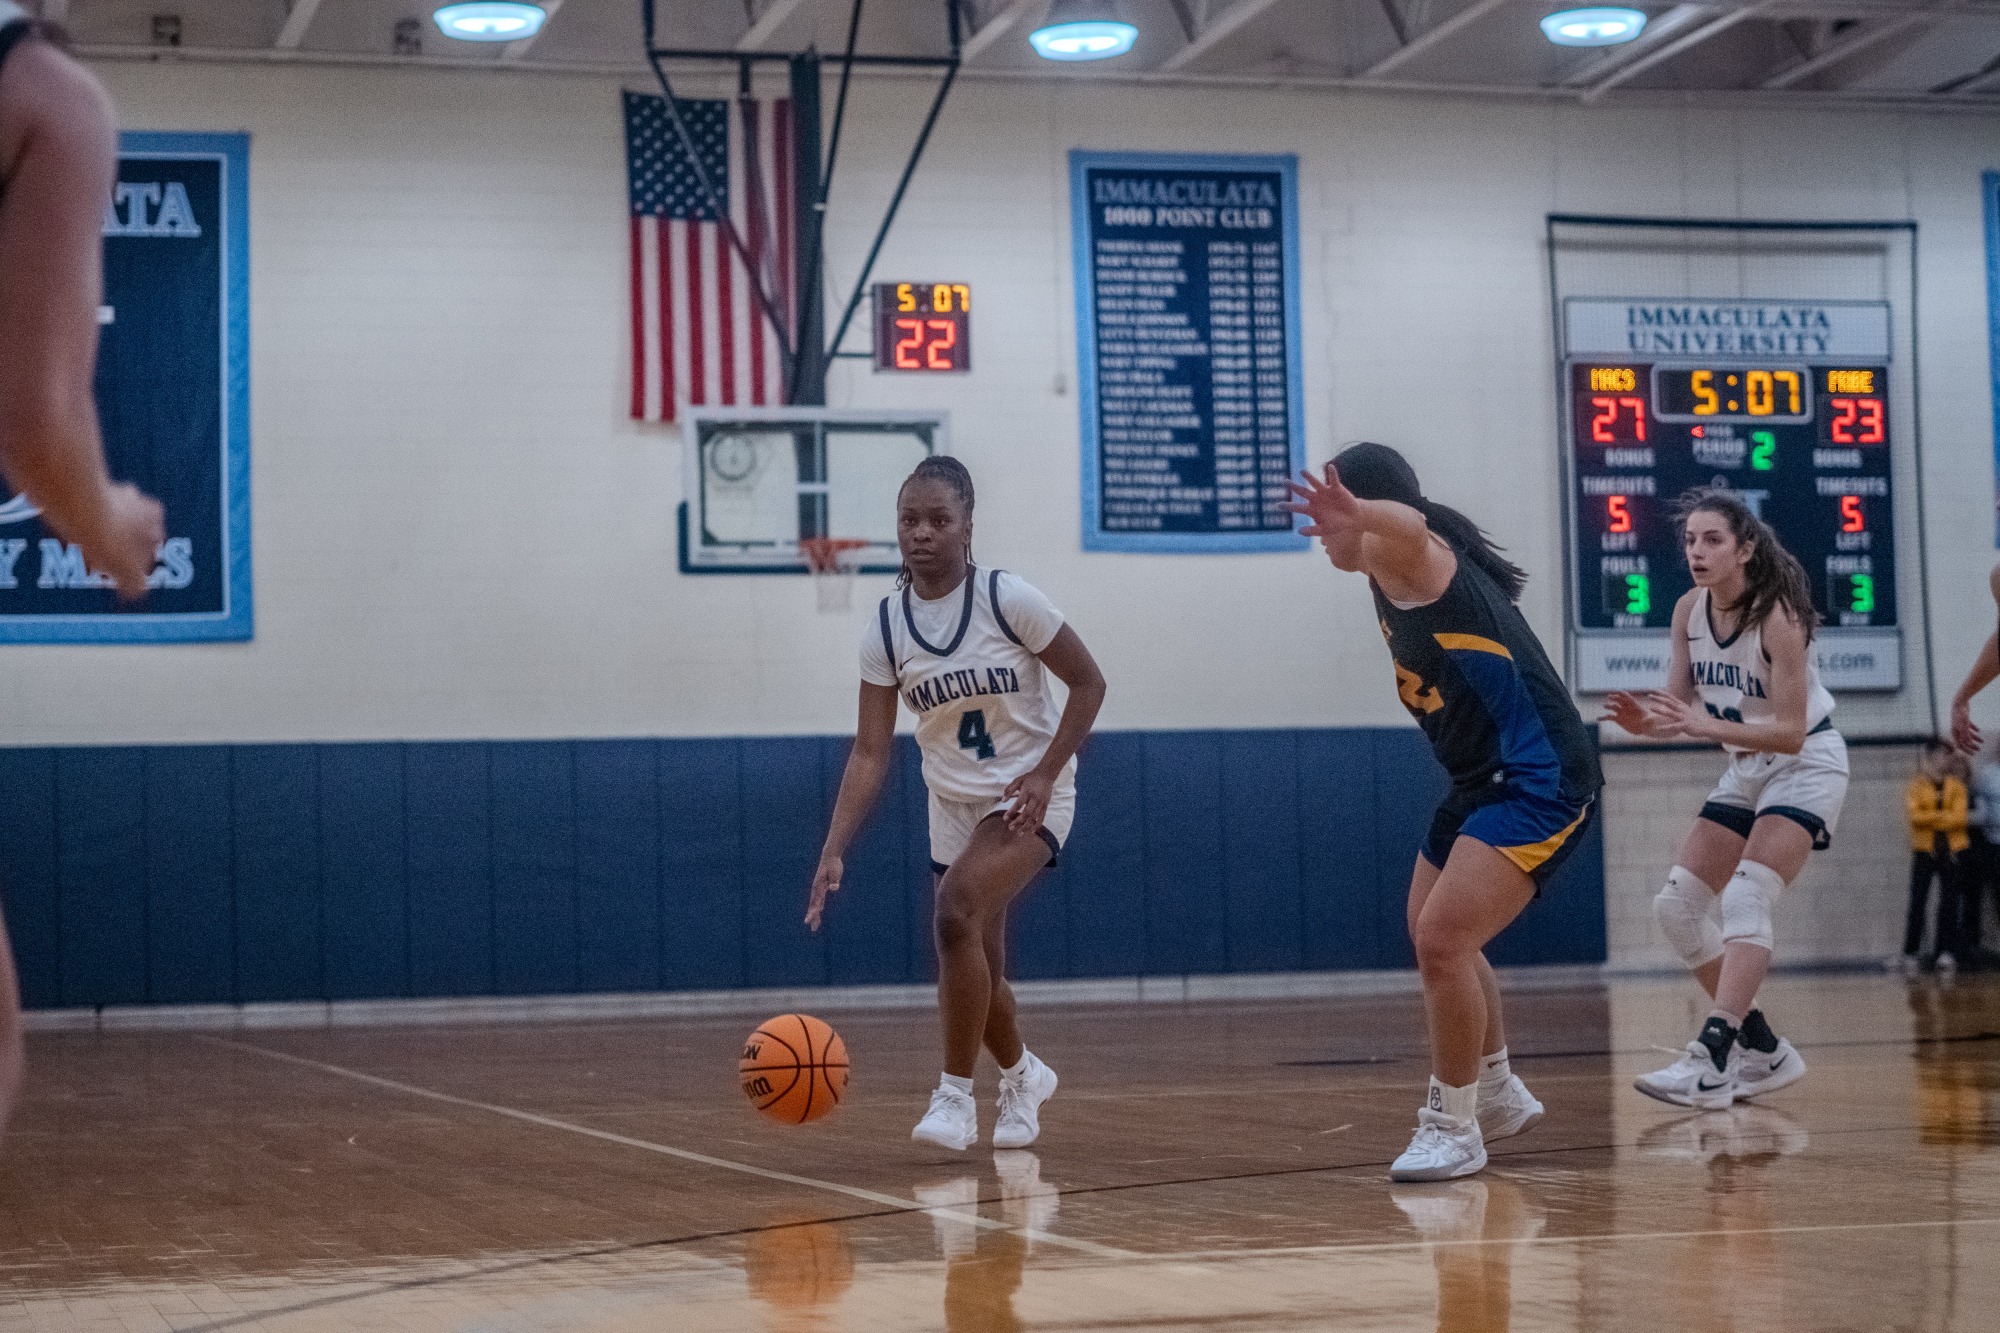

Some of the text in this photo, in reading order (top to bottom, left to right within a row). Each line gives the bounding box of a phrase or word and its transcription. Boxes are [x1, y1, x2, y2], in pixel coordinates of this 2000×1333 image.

[1094, 178, 1277, 206] IMMACULATA
[1105, 206, 1272, 228] 1000 POINT CLUB
[1628, 307, 1830, 328] IMMACULATA
[896, 319, 957, 368] 22
[1628, 331, 1830, 354] UNIVERSITY
[1590, 368, 1636, 391] MACS
[1691, 370, 1800, 416] 5:07
[1591, 397, 1646, 442] 27
[1831, 398, 1885, 444] 23
[1605, 448, 1655, 467] BONUS
[1752, 431, 1775, 470] 2
[1582, 476, 1656, 495] TIMEOUTS
[1815, 477, 1888, 496] TIMEOUTS
[1608, 496, 1632, 533] 5
[1841, 496, 1864, 533] 5
[1601, 556, 1648, 574] FOULS
[1626, 573, 1650, 614] 3
[1851, 573, 1875, 612] 3
[957, 709, 997, 761] 4
